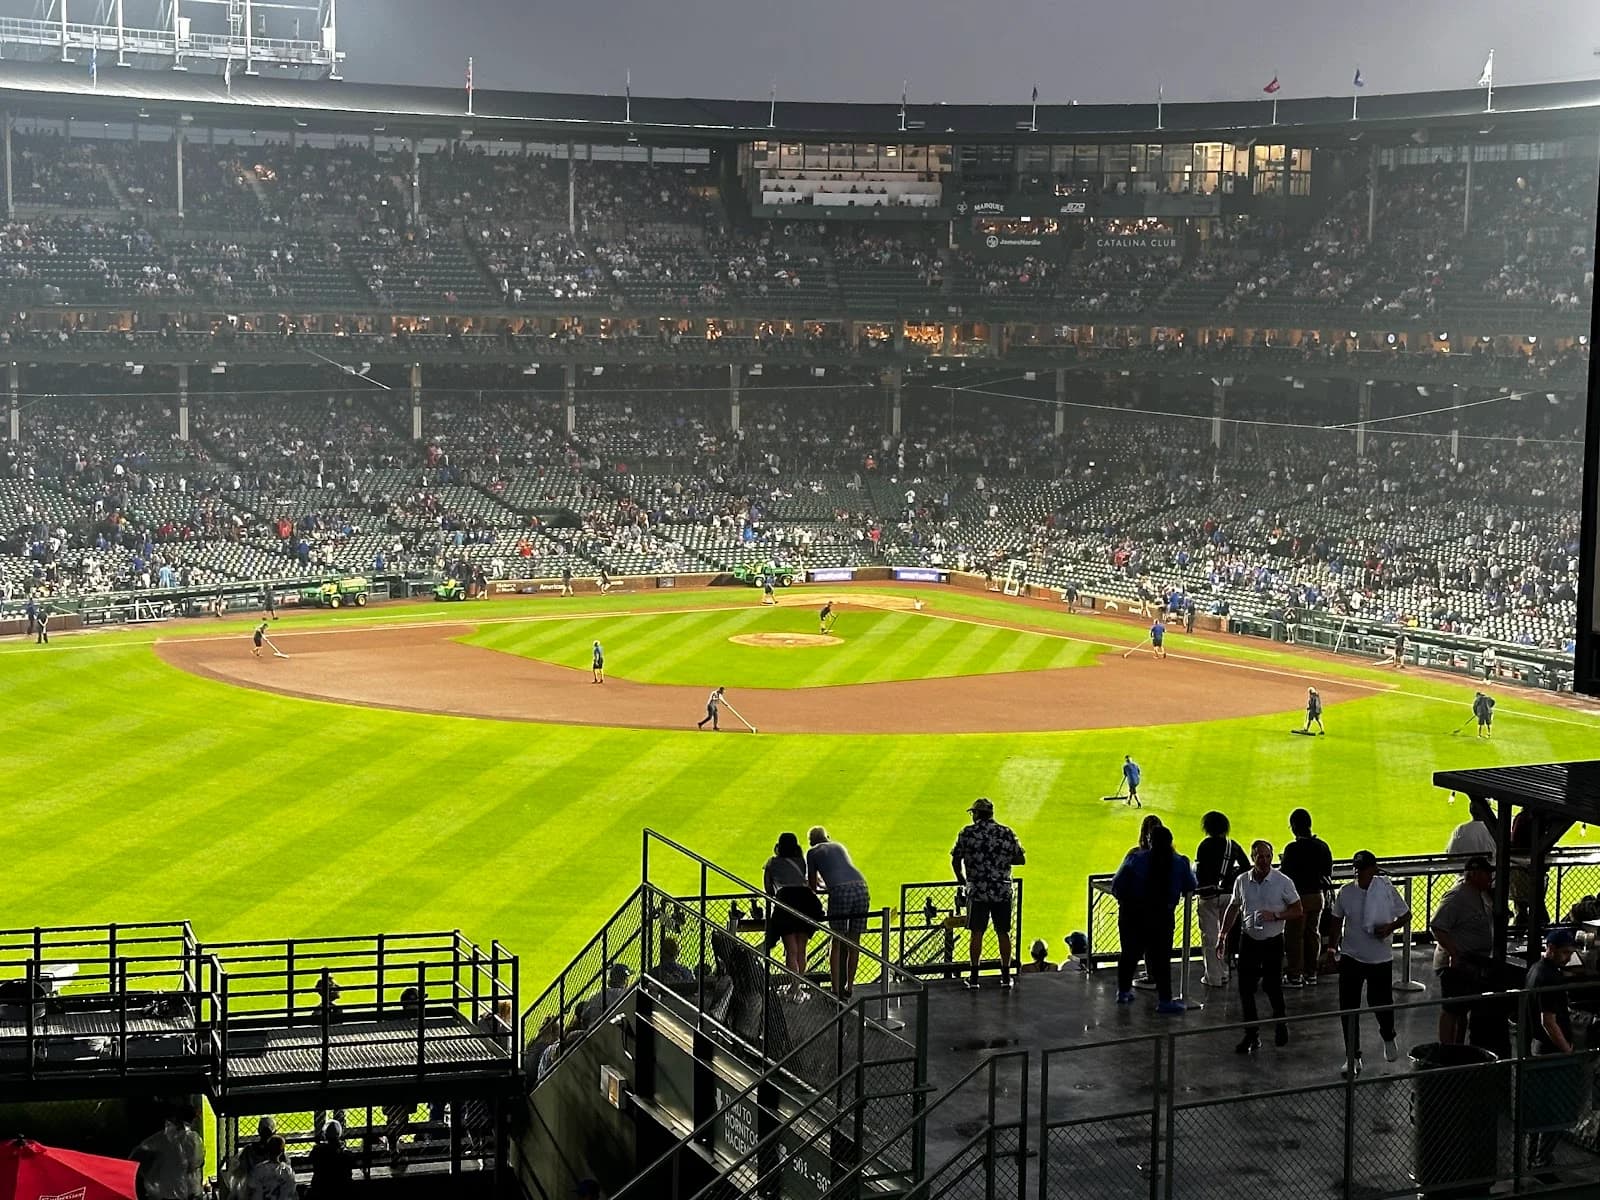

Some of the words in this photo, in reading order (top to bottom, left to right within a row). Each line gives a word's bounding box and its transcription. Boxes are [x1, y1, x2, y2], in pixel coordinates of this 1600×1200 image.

[974, 202, 1004, 211] MARQUEE
[1096, 239, 1146, 247] CATALINA
[1150, 239, 1176, 247] CLUB
[742, 1106, 752, 1125] TO
